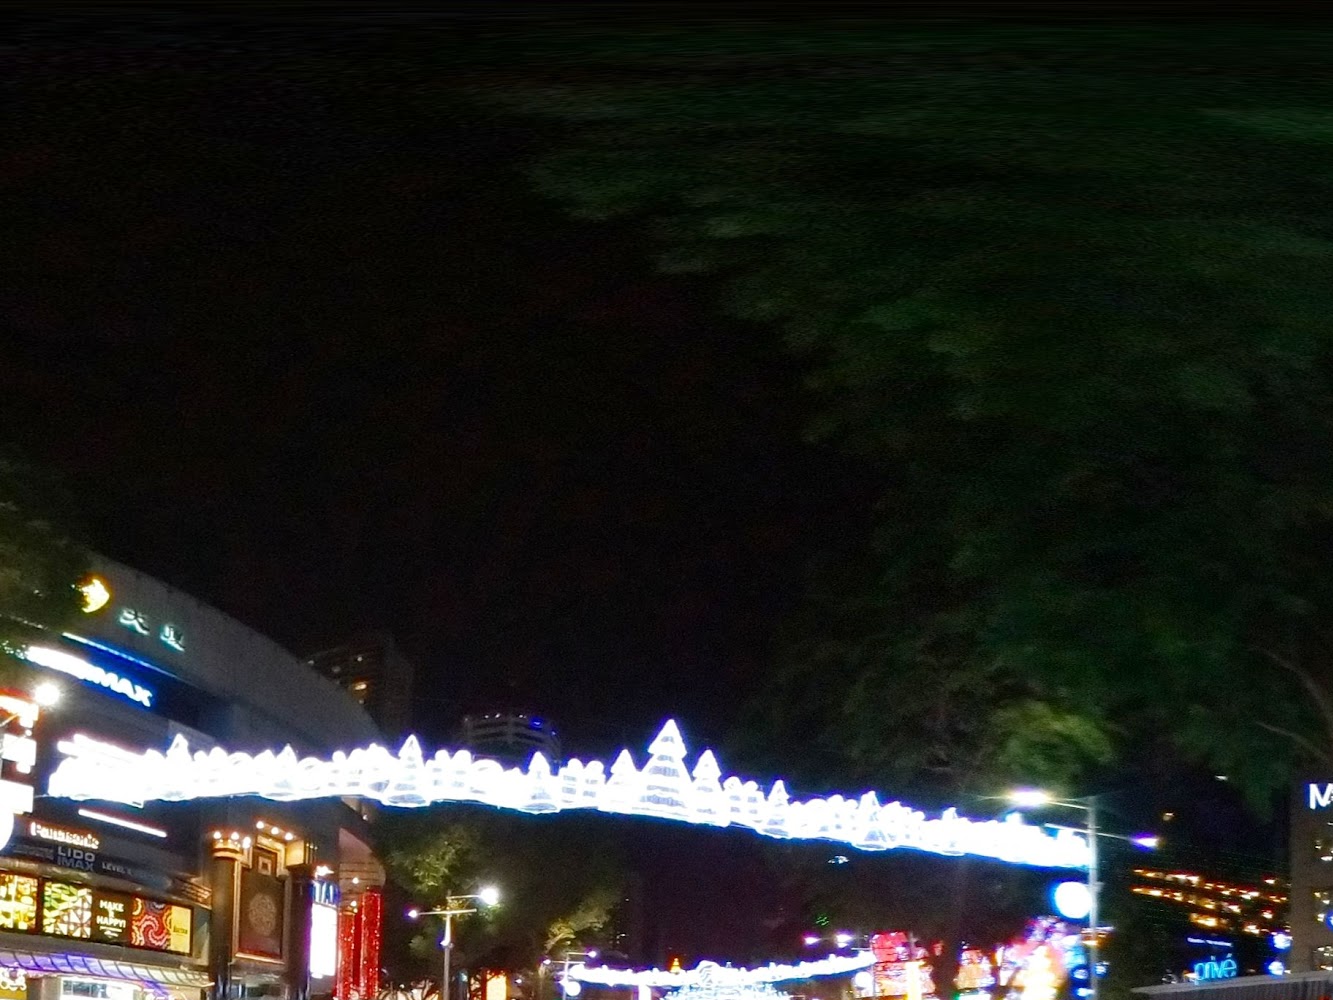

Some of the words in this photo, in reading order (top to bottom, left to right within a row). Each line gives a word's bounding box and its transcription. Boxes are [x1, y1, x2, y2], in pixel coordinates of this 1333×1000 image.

[57, 846, 95, 862] LIDO
[57, 856, 95, 871] IMAX
[100, 899, 124, 912] MAKE
